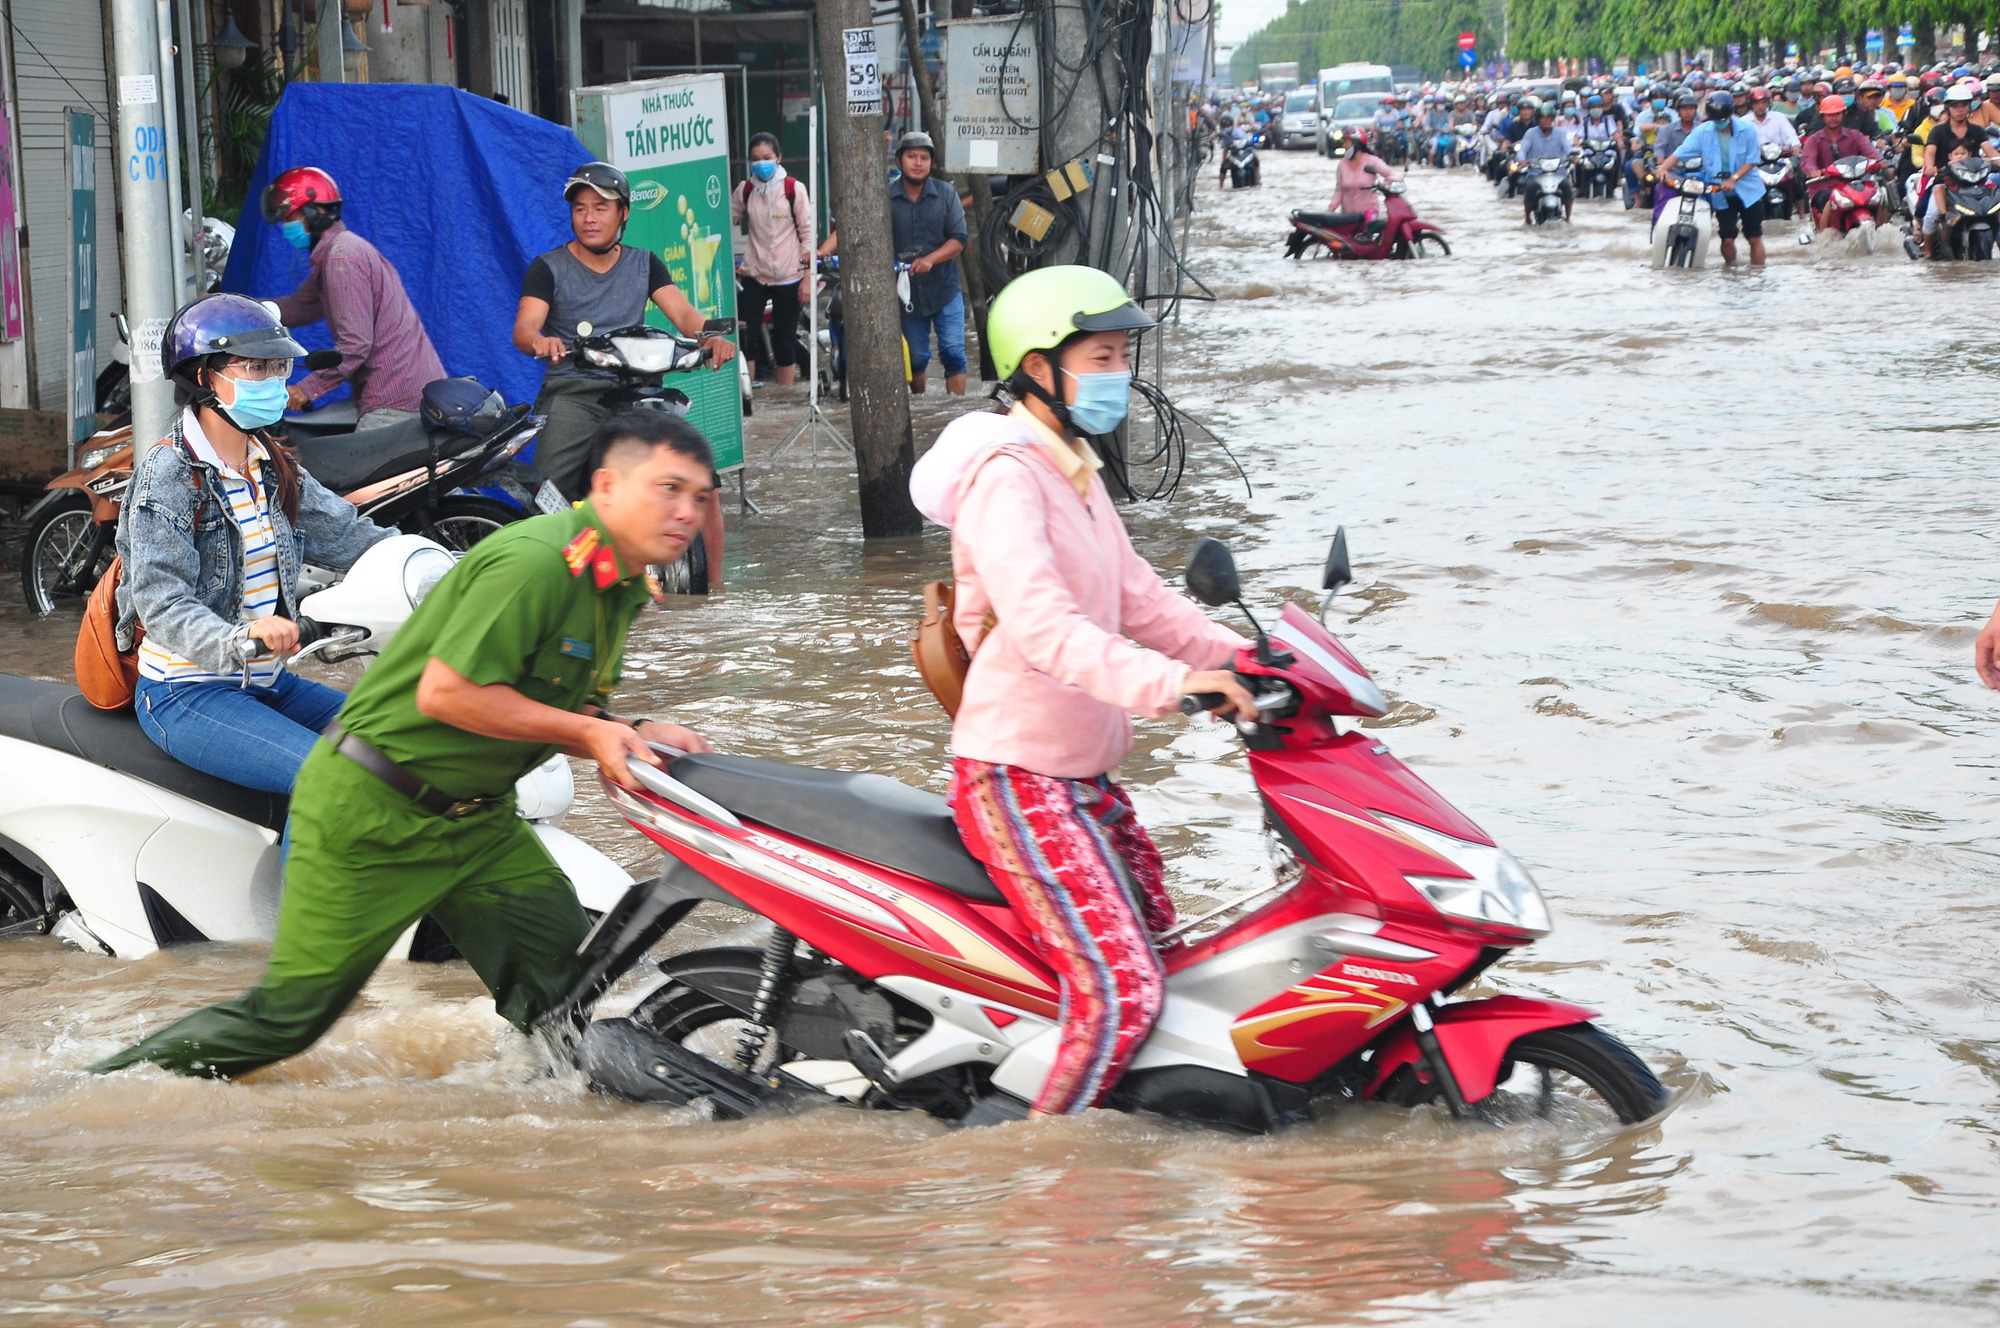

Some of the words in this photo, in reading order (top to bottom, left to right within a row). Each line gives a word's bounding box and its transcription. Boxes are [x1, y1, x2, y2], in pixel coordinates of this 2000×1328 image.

[642, 93, 662, 113] NHÀ
[663, 87, 694, 110] THUỐC
[626, 120, 657, 157] TẤN
[660, 114, 715, 152] PHƯỚC
[990, 126, 1005, 135] 222
[1007, 126, 1017, 135] 10
[630, 188, 659, 203] Berocca
[92, 477, 115, 491] 110
[1341, 963, 1419, 986] HONDA
